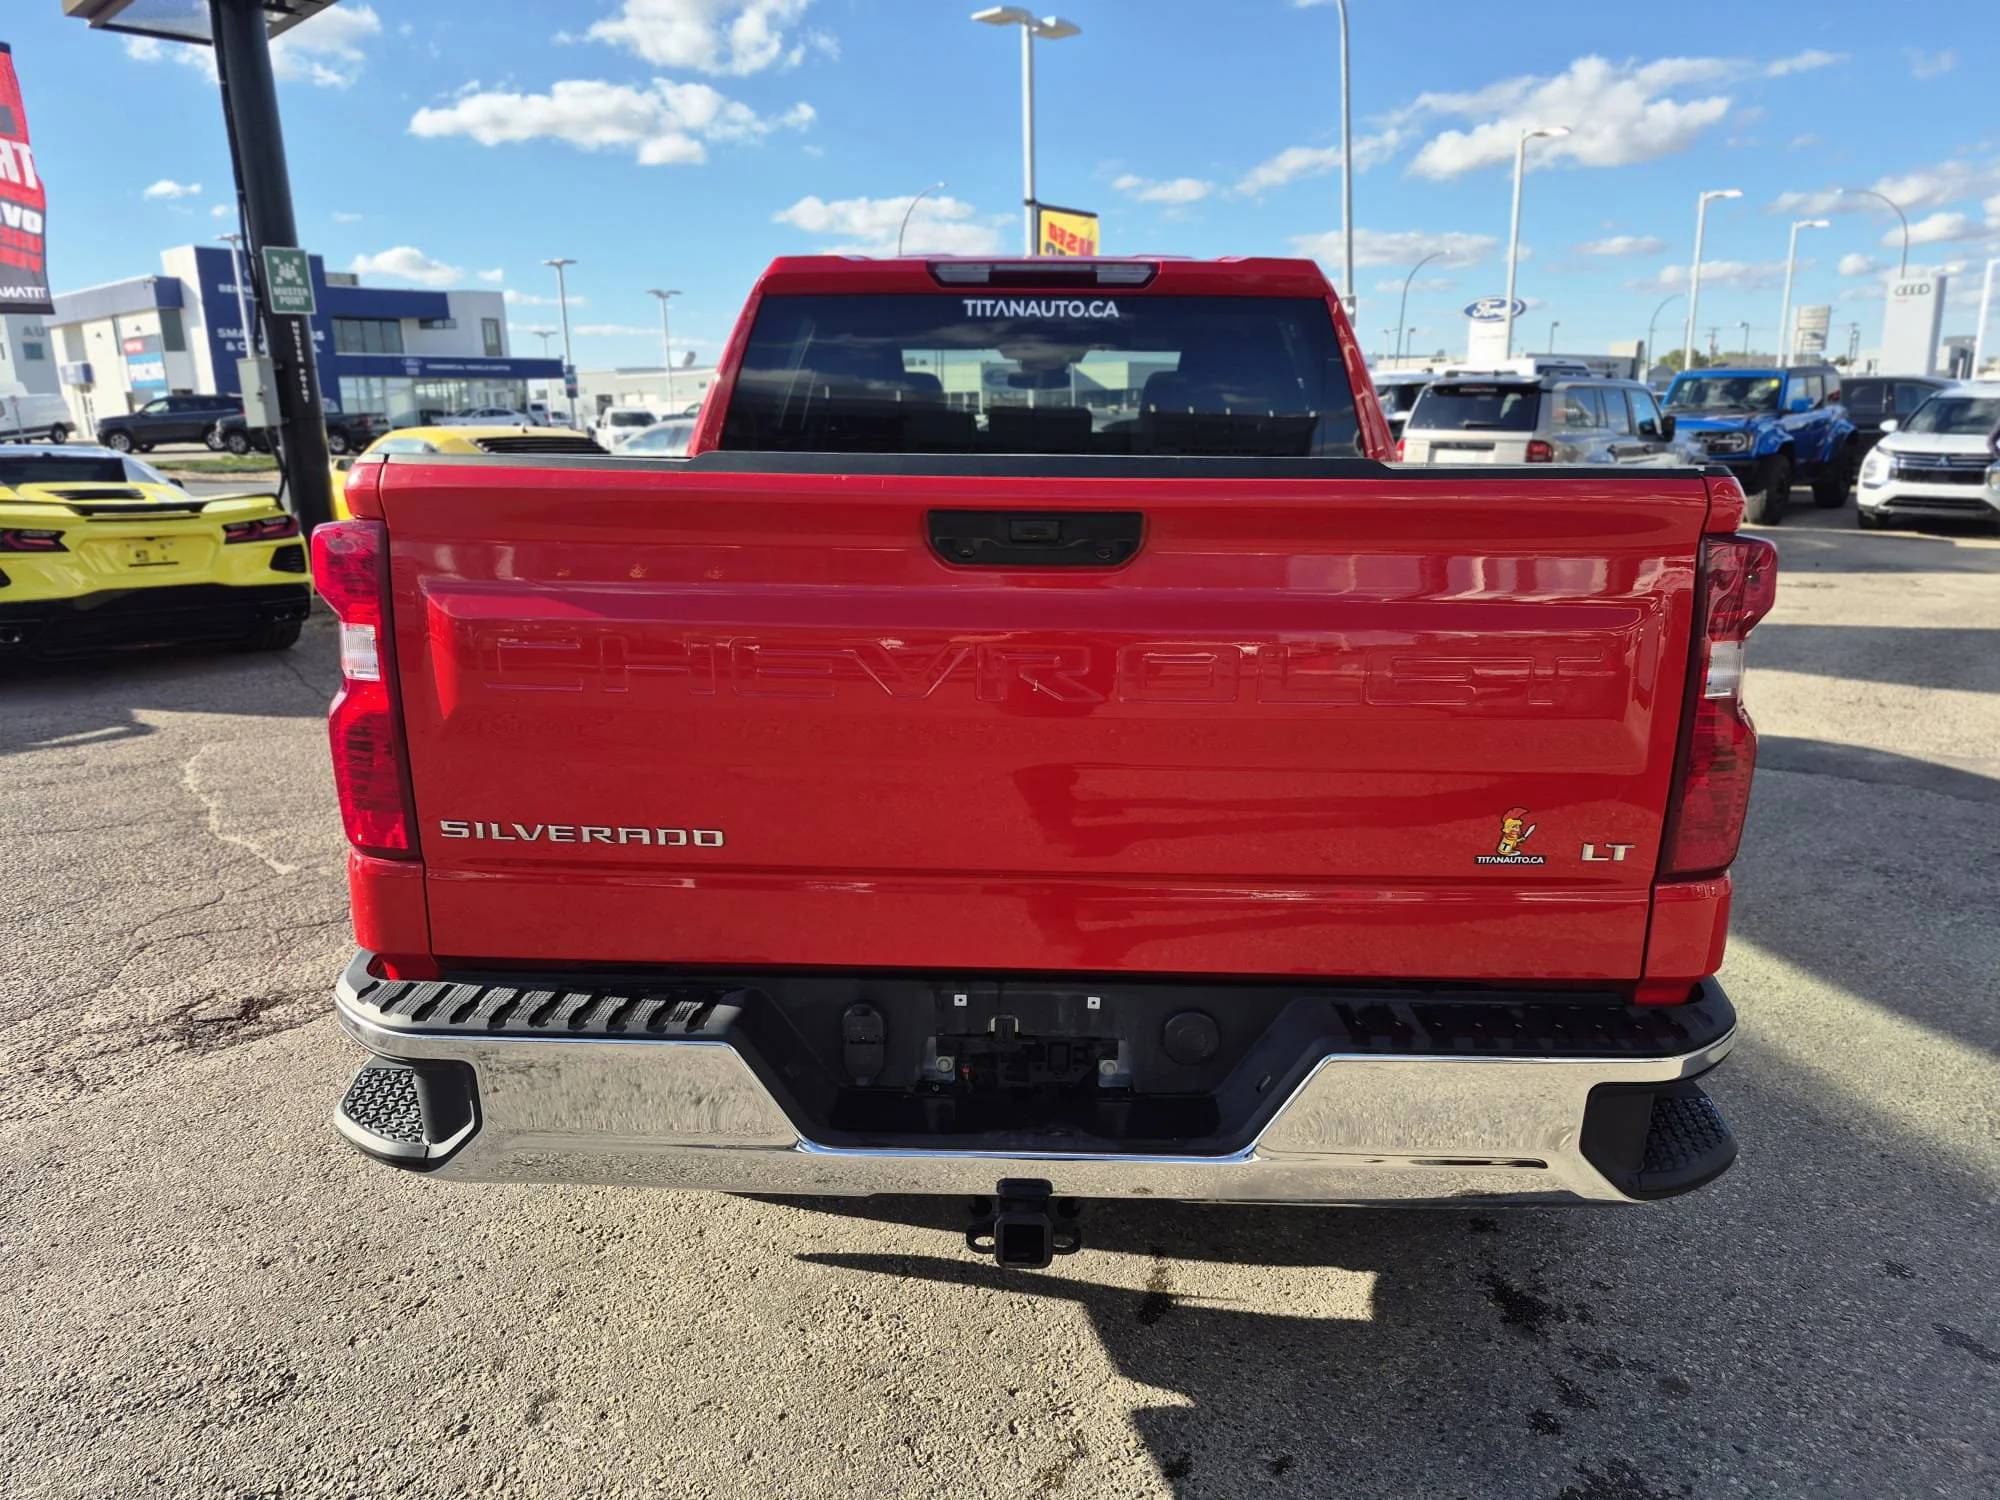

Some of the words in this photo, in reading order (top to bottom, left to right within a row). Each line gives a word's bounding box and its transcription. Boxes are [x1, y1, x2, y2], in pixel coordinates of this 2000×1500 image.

[273, 286, 309, 296] MUSTER
[279, 295, 305, 305] POINT
[963, 299, 1119, 318] TITANAUTO.CA
[290, 320, 304, 363] MUSTER
[299, 368, 309, 403] POINT
[482, 630, 1604, 705] CHEVROLET
[439, 820, 725, 847] SILVERADO
[1476, 856, 1545, 865] TITANAUTO.CA
[1581, 843, 1636, 861] LT
